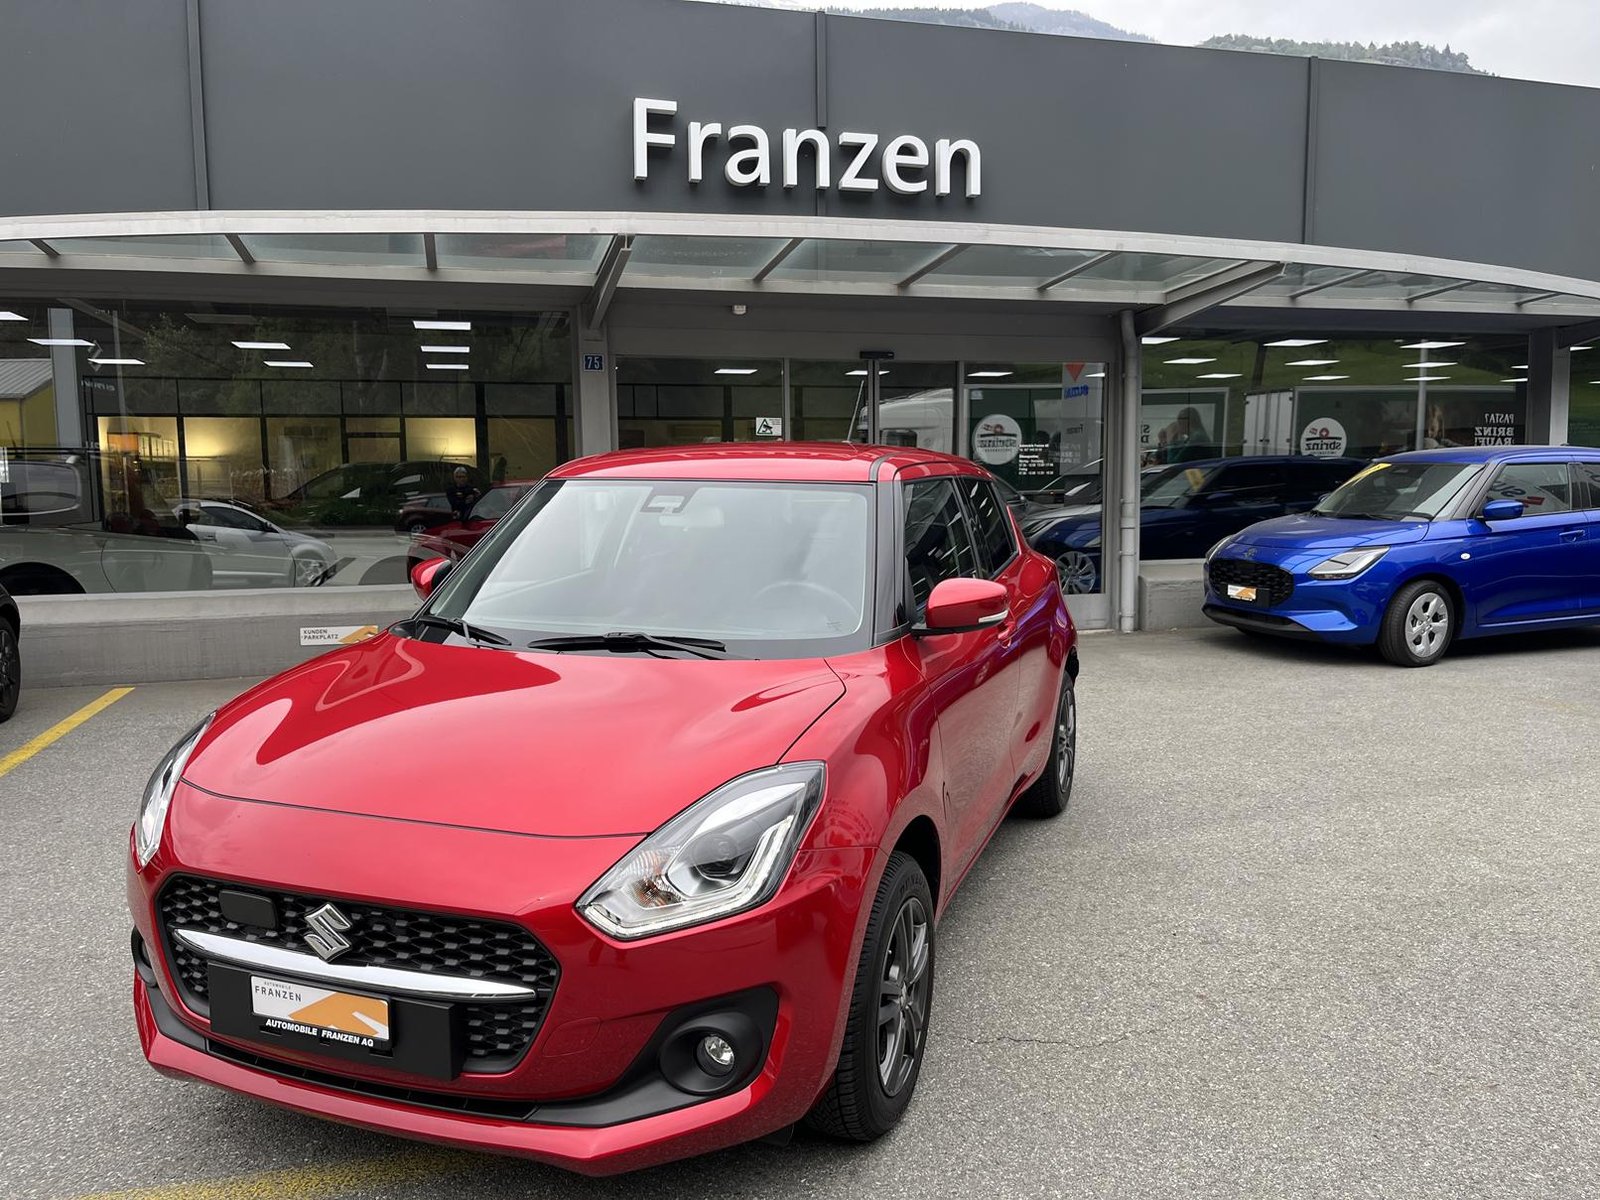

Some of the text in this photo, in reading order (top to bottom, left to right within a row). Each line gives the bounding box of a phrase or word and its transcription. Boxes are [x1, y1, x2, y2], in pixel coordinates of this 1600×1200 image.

[633, 97, 981, 198] Franzen
[587, 356, 600, 369] 75
[254, 985, 302, 1002] FRANZEN
[265, 1018, 374, 1047] AUTOMOBILE FRANZEN AG
